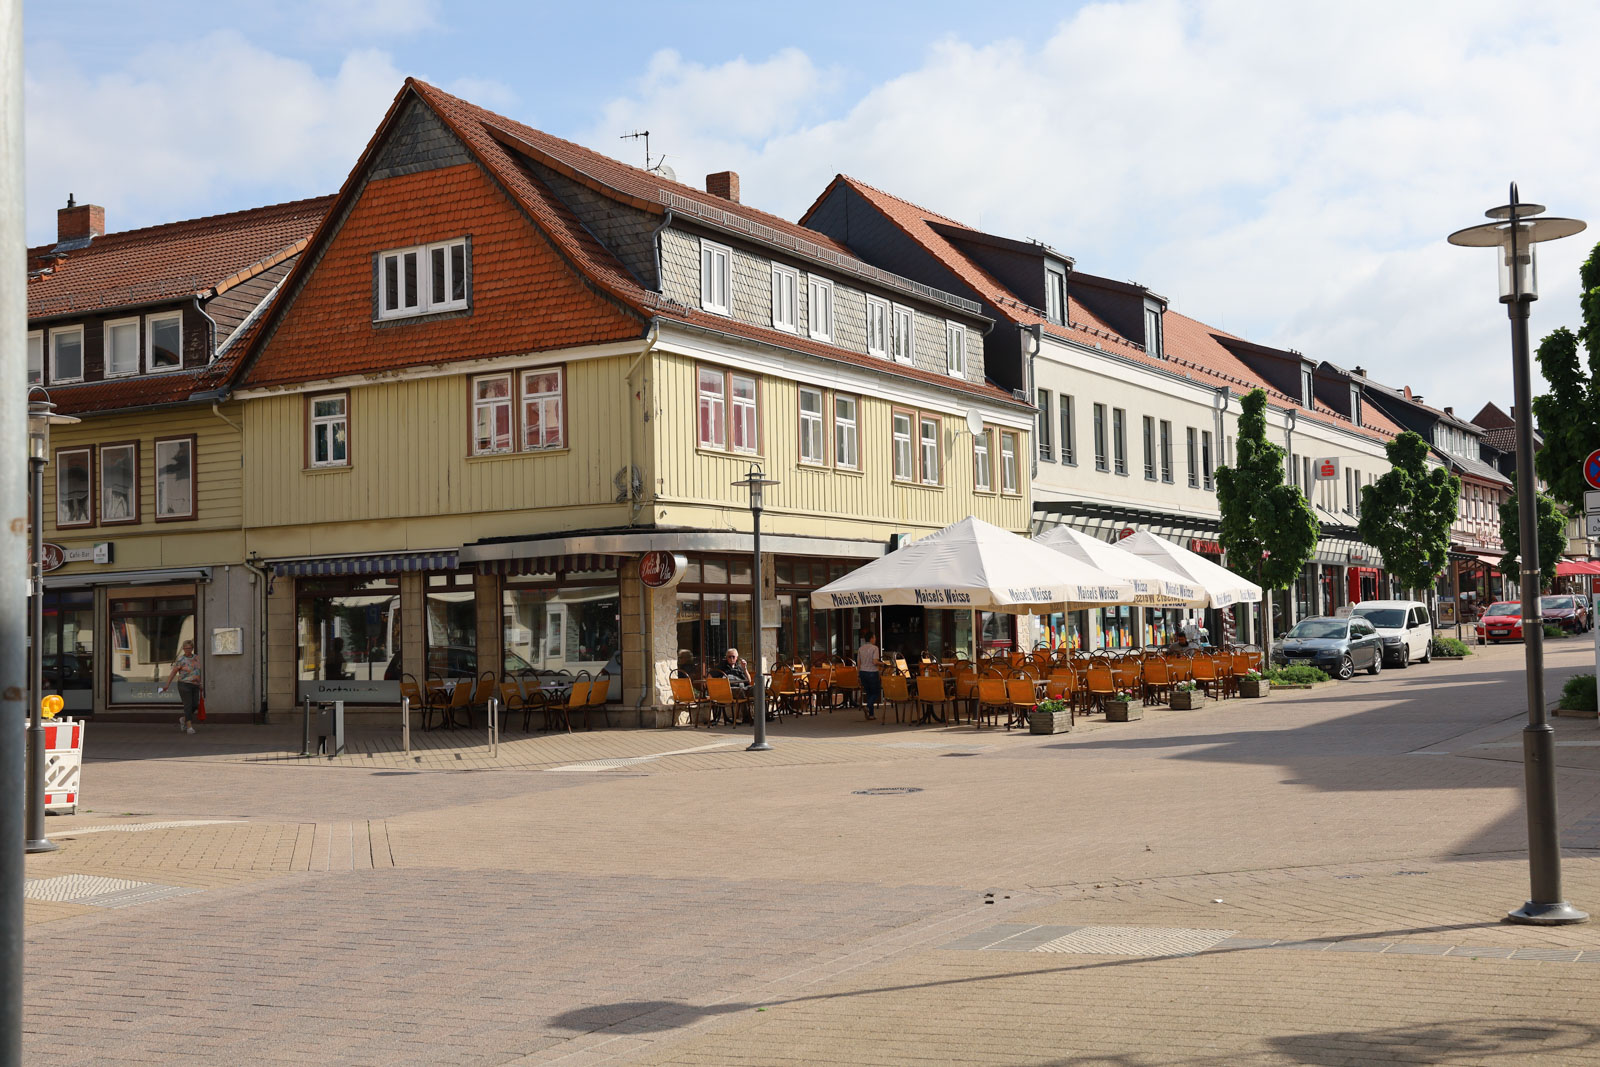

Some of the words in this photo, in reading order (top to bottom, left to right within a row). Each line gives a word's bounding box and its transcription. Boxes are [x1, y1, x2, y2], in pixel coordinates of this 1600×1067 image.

[830, 592, 859, 607] Maisel's
[857, 591, 884, 605] Weisse
[914, 589, 944, 604] Maisel's
[944, 589, 971, 604] Weisse
[1008, 588, 1032, 601] Maisel's
[1030, 587, 1053, 601] Weisse
[1077, 586, 1098, 600] Maisel's
[1098, 586, 1119, 600] Weisse
